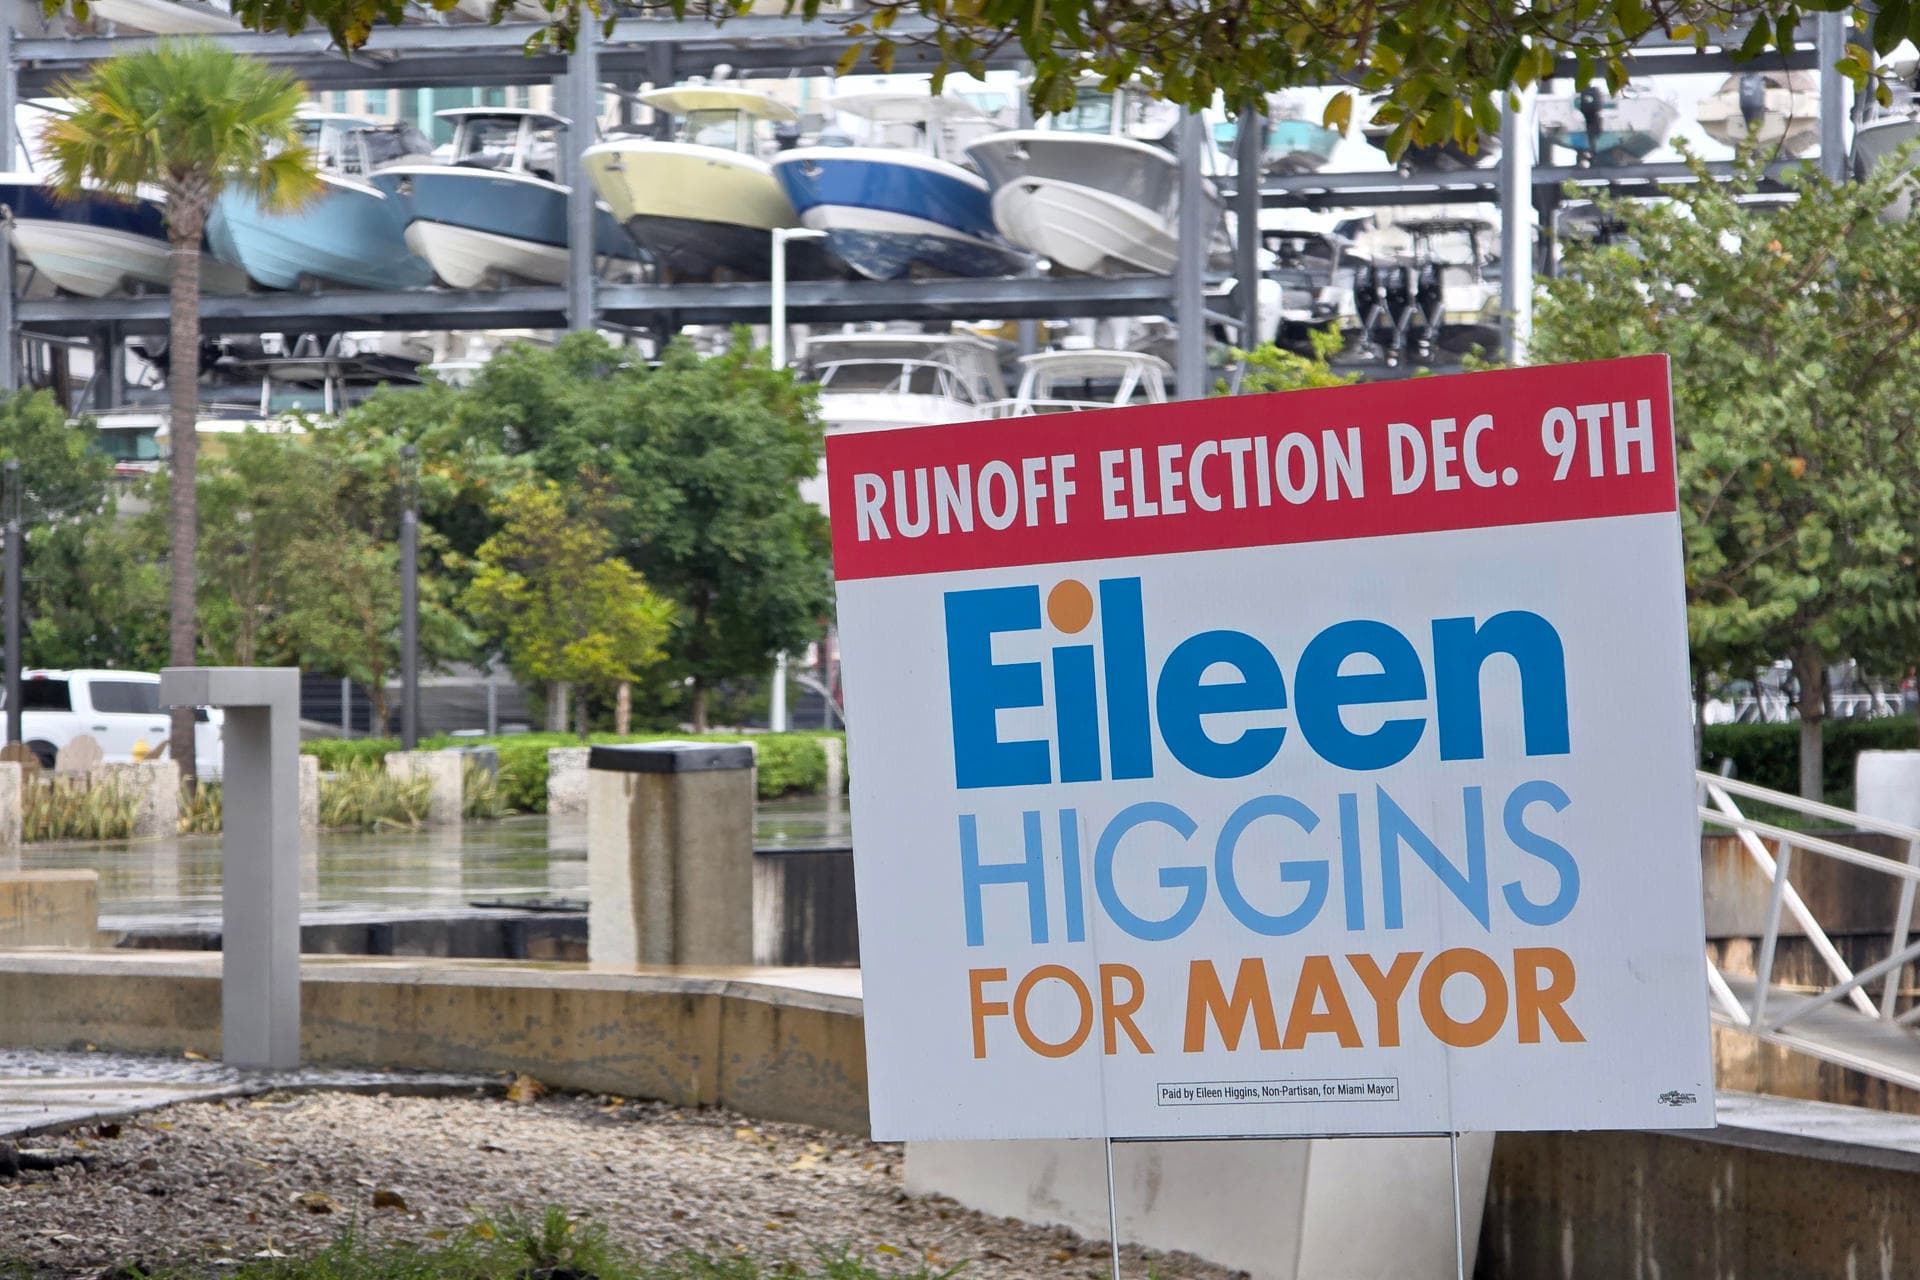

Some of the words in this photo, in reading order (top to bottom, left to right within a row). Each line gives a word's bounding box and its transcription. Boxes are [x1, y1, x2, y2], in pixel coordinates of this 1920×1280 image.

[854, 454, 1077, 542] RUNOFF
[1100, 427, 1365, 521] ELECTION
[1388, 414, 1519, 495] DEC.
[1542, 399, 1656, 481] 9TH
[944, 576, 1572, 790] Eileen
[959, 780, 1581, 948] HIGGINS
[970, 964, 1153, 1059] FOR
[1184, 948, 1585, 1053] MAYOR
[1162, 1088, 1182, 1099] Paid
[1183, 1087, 1195, 1101] by
[1196, 1086, 1223, 1097] Eileen
[1224, 1086, 1260, 1100] Higgins,
[1261, 1085, 1321, 1097] Non-Partisan,
[1322, 1083, 1336, 1096] for
[1337, 1083, 1365, 1095] Miami
[1366, 1083, 1395, 1097] Mayor
